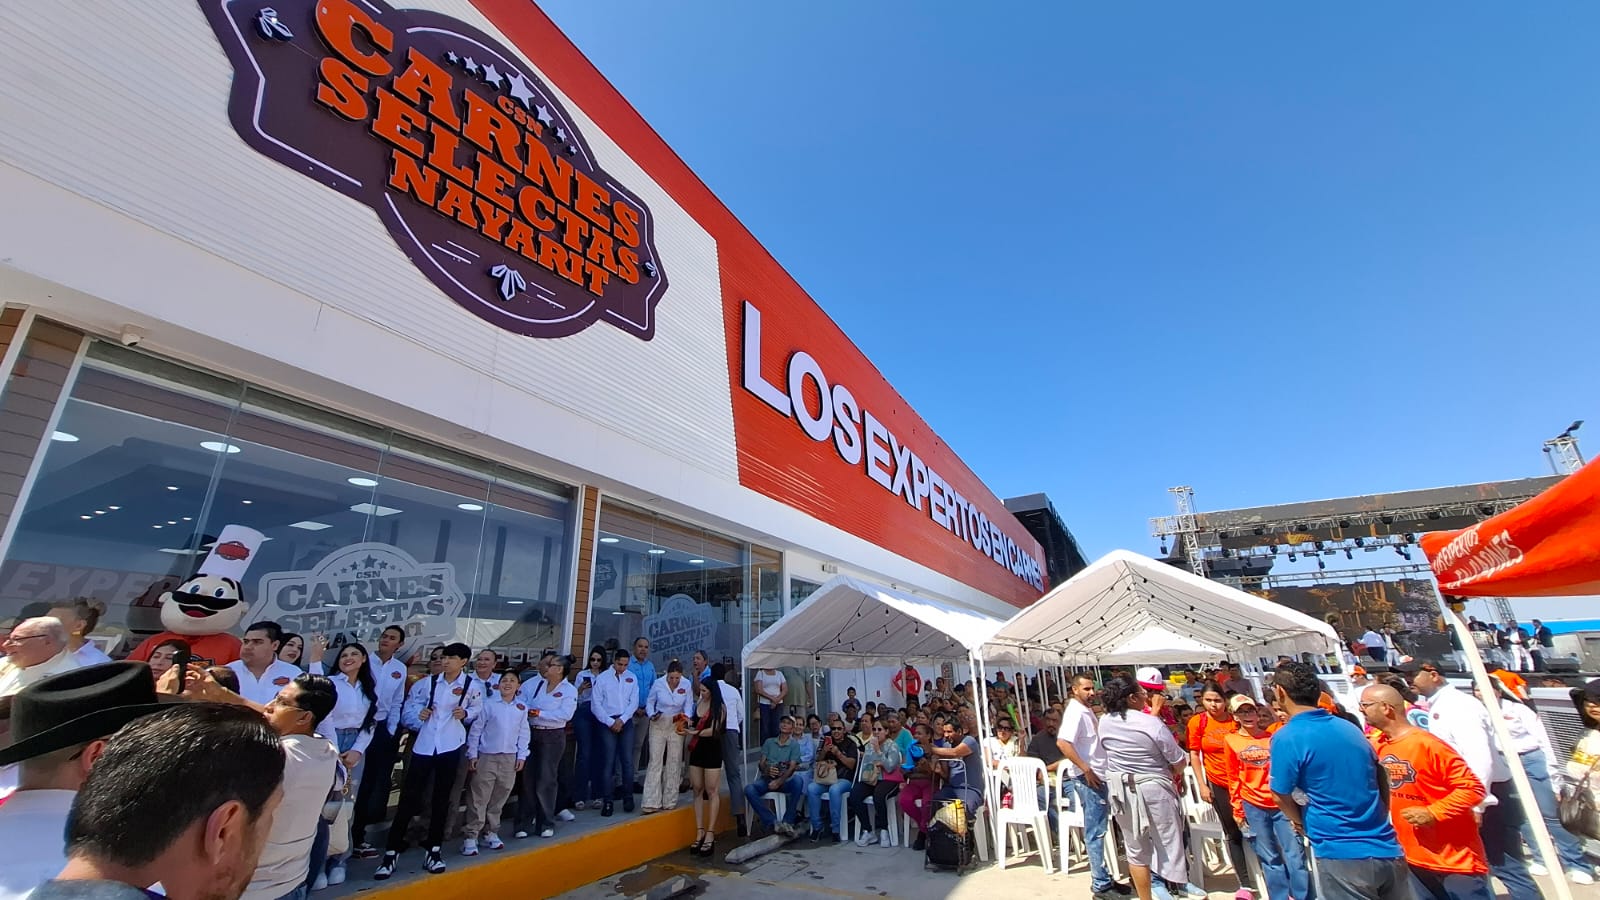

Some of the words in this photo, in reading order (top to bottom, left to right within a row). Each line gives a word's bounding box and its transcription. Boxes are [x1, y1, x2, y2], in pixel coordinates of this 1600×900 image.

[315, 0, 640, 248] CARNES
[498, 95, 544, 136] CSN
[317, 57, 640, 285] SELECTAS
[387, 150, 609, 297] NAYARIT
[742, 300, 862, 466] LOS
[863, 409, 992, 558] EXPERTOS
[276, 573, 444, 612] CARNES
[355, 570, 382, 579] CSN
[276, 598, 445, 634] SELECTAS
[650, 622, 711, 653] SELECTAS
